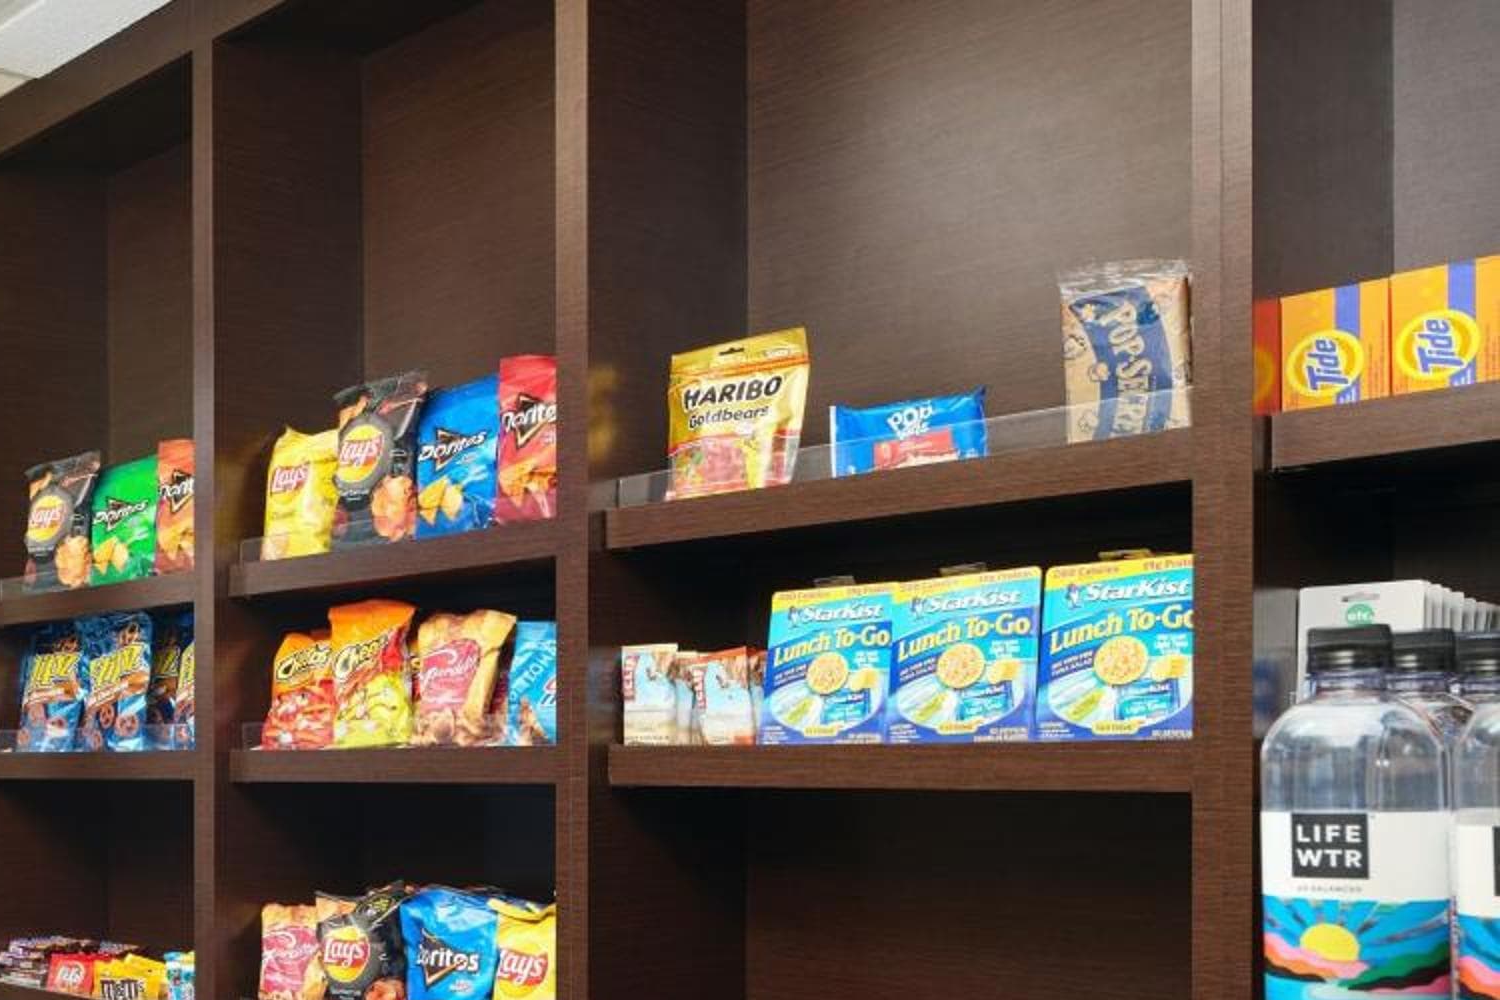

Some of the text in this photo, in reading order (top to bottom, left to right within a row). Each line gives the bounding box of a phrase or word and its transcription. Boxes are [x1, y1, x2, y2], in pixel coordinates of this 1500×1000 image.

[1417, 319, 1466, 374] Tide
[1307, 339, 1351, 391] Tide
[684, 376, 783, 410] HARIBO
[689, 405, 770, 428] Goldbears
[418, 431, 488, 462] Doritos
[929, 589, 1021, 612] StarKist
[1086, 578, 1190, 600] StarKist
[802, 602, 884, 621] StarKist
[899, 623, 961, 661] Lunch
[1051, 613, 1123, 653] Lunch
[774, 631, 831, 667] Lunch
[1296, 824, 1363, 843] LIFE
[1297, 849, 1363, 868] WTR
